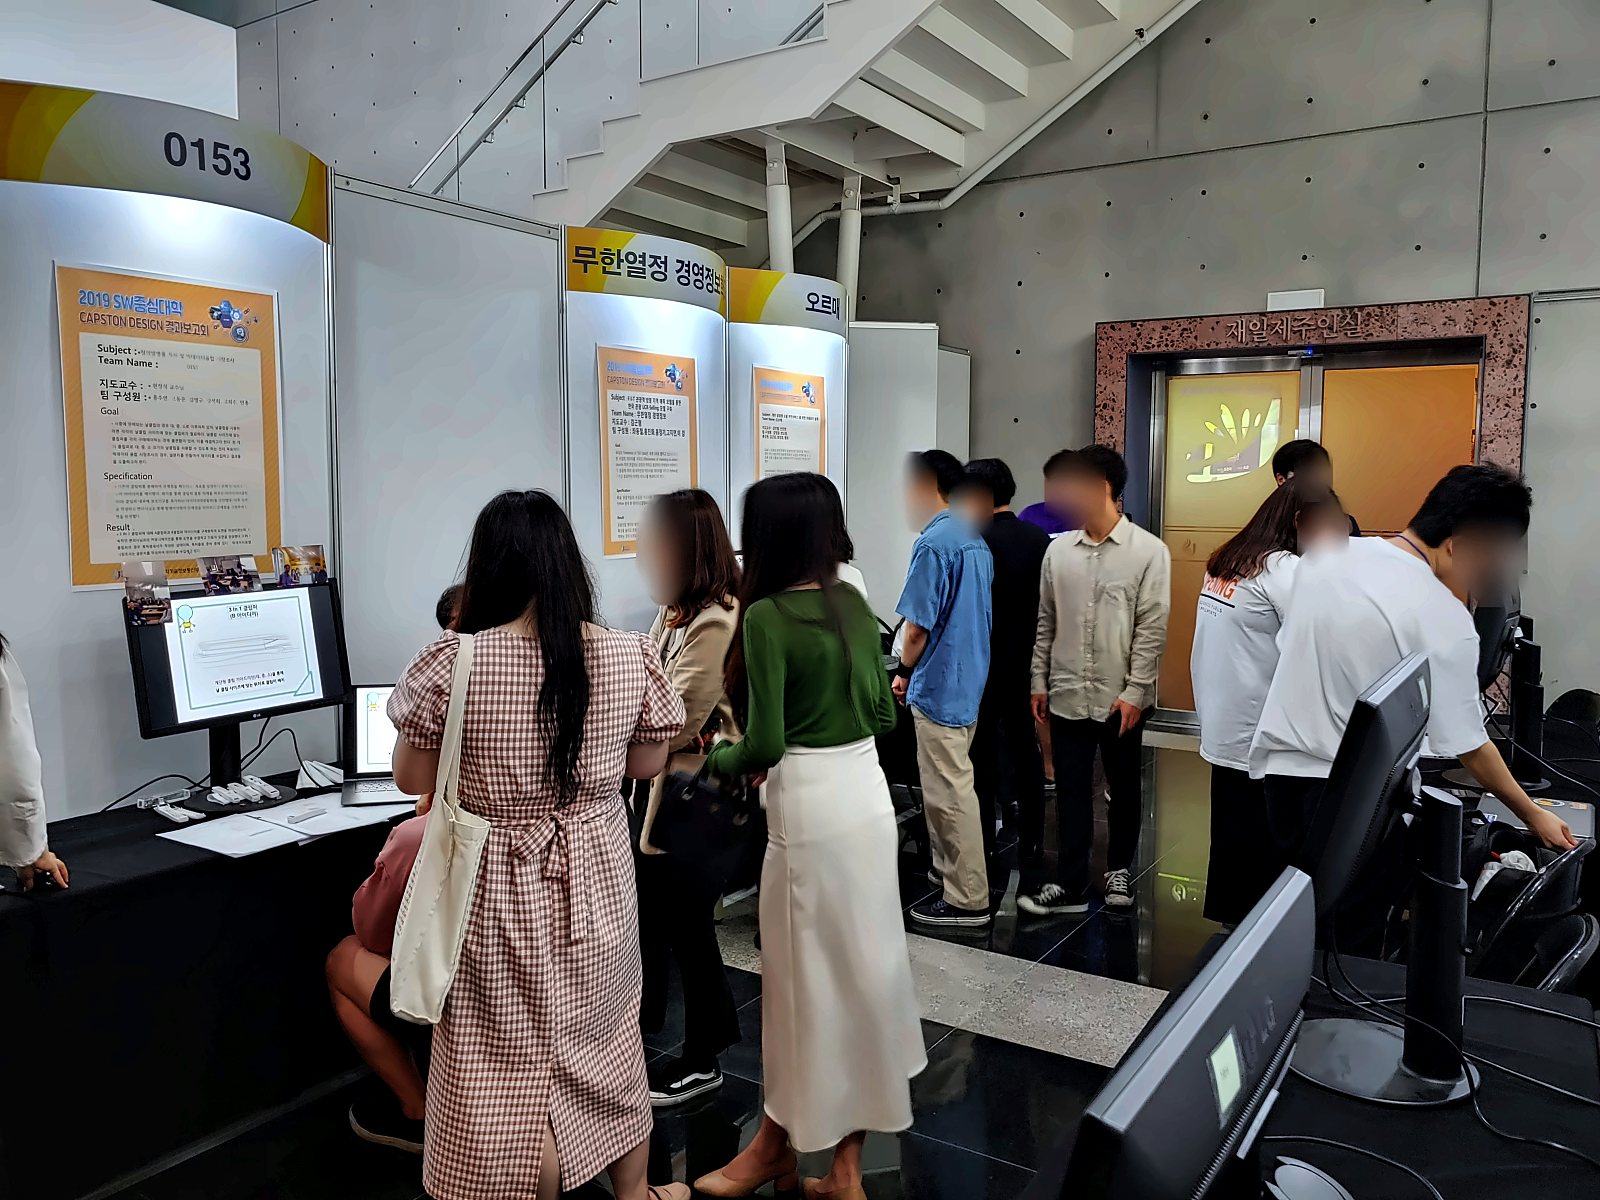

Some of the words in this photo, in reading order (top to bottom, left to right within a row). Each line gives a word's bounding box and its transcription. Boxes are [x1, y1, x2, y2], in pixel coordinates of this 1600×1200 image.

[163, 131, 251, 181] 0153
[572, 245, 669, 282] 무한열정
[79, 289, 110, 309] 2019
[113, 294, 183, 317] SW중심대학
[79, 311, 128, 328] CAPSTON
[128, 317, 164, 331] DESIGN
[165, 320, 209, 336] 결과보고회
[1226, 311, 1362, 343] 재일제주인실
[97, 344, 132, 357] Subject
[98, 355, 124, 367] Team
[126, 357, 153, 368] Name
[99, 379, 138, 390] 지도교수
[100, 390, 109, 401] 팀
[112, 391, 141, 402] 구성원
[100, 406, 119, 416] Goal
[103, 472, 153, 482] Specification
[106, 523, 131, 532] Result
